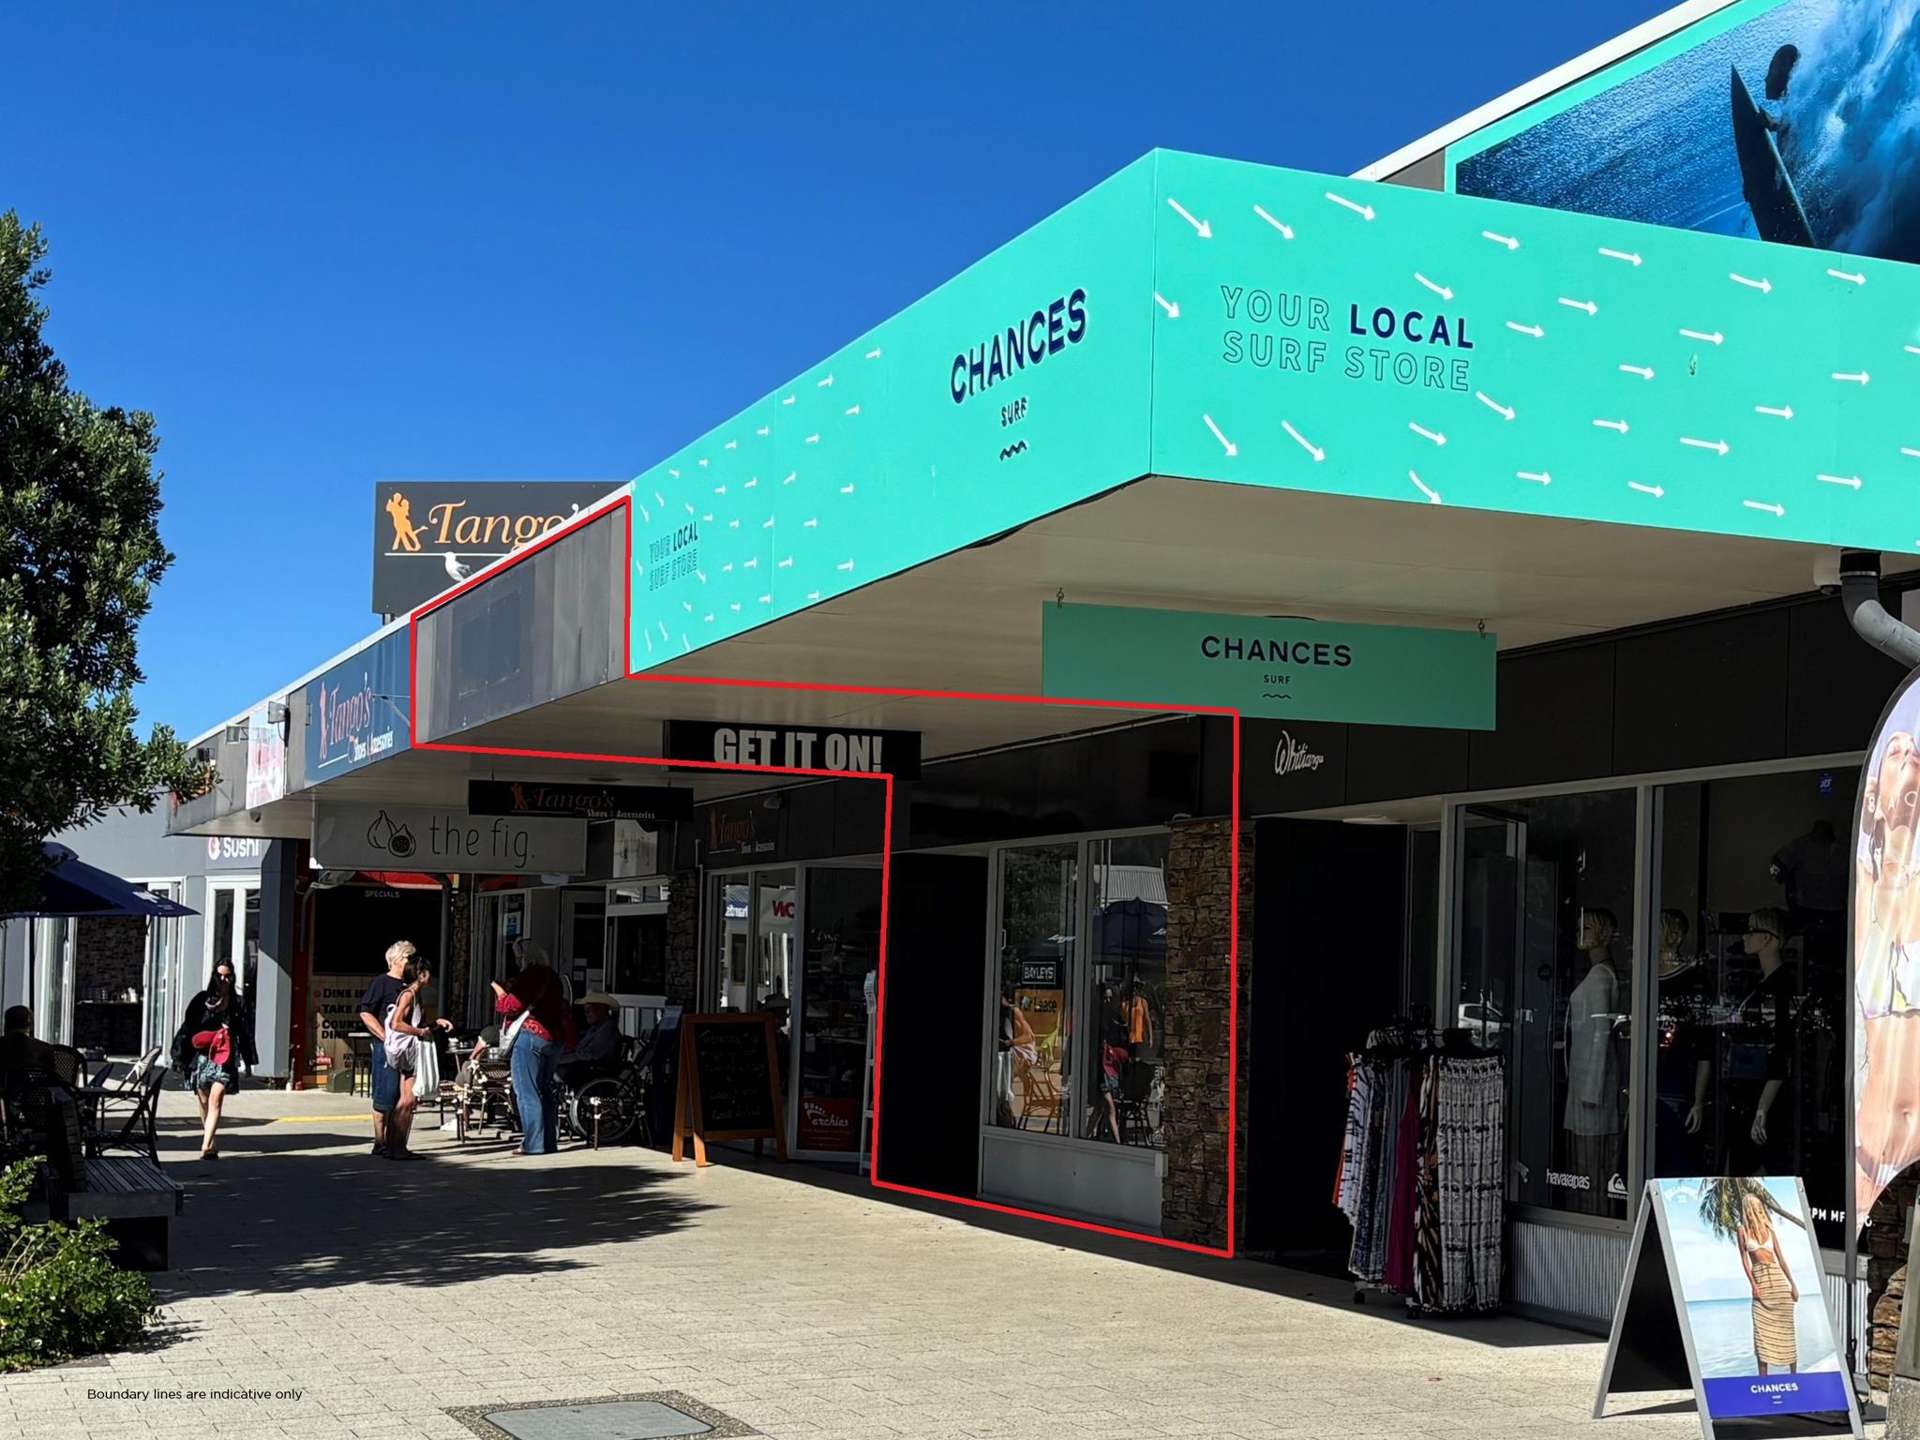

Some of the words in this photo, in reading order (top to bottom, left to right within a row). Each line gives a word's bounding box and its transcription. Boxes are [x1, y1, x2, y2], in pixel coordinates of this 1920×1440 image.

[1219, 284, 1330, 333] YOUR
[1348, 303, 1475, 349] LOCAL
[951, 288, 1087, 405] CHANCES
[1222, 330, 1328, 374] SURF
[1344, 346, 1471, 393] STORE
[1001, 397, 1027, 427] SURF
[429, 499, 579, 552] Tango'
[673, 521, 698, 552] LOCAL
[1201, 635, 1353, 667] CHANCES
[1263, 674, 1292, 685] SURF
[713, 727, 776, 766] GET
[785, 732, 817, 770] IT
[825, 733, 883, 773] ON!
[429, 815, 480, 857] the
[490, 818, 535, 869] fig.
[1808, 1207, 1827, 1221] PM
[1750, 1382, 1799, 1394] CHANCES
